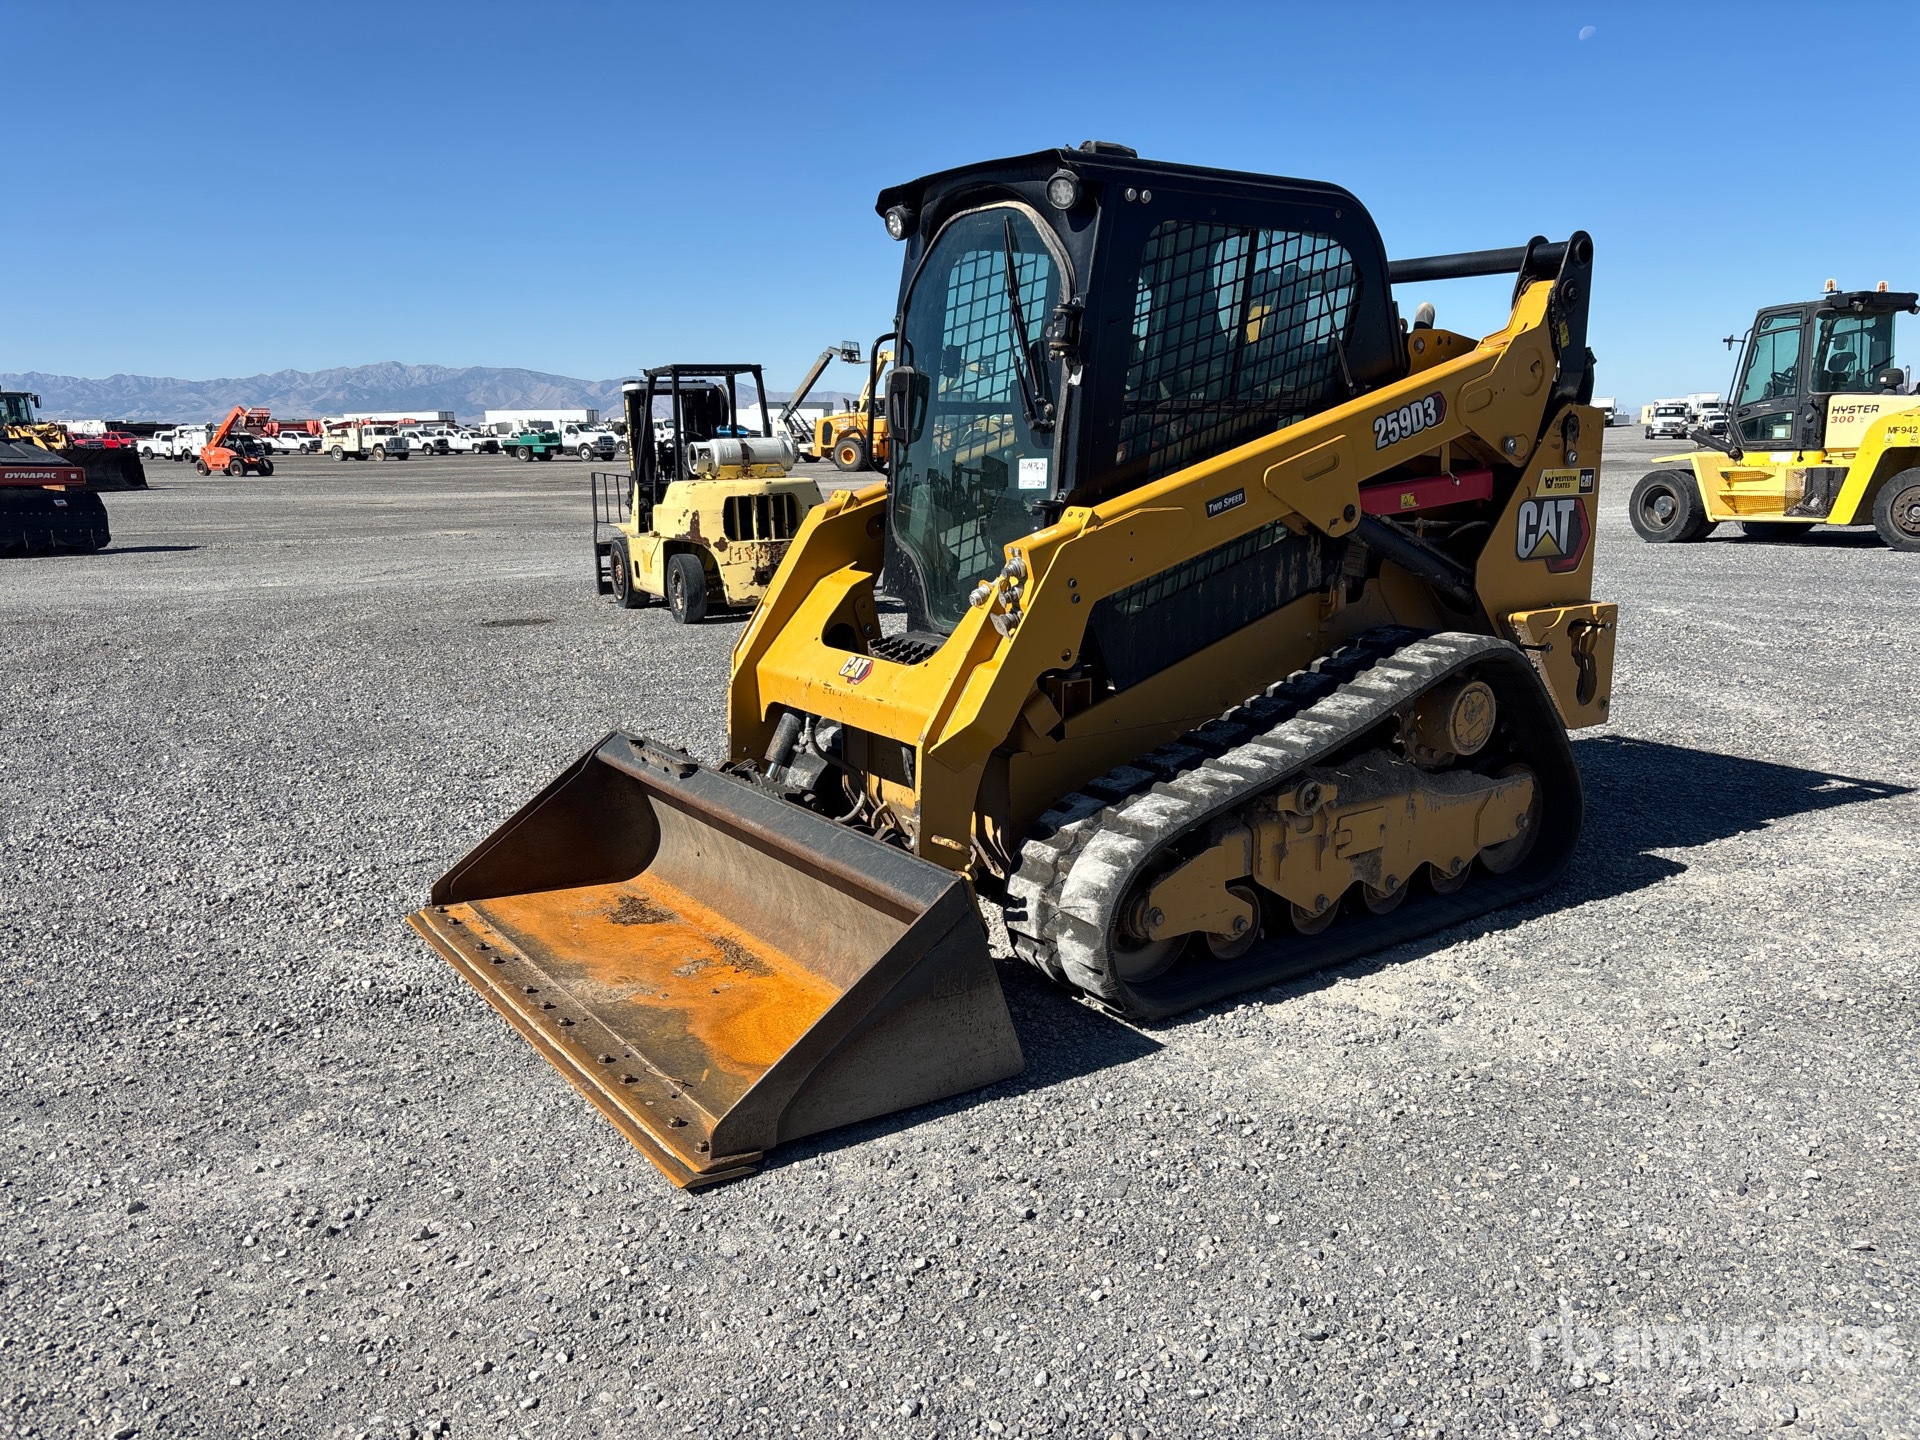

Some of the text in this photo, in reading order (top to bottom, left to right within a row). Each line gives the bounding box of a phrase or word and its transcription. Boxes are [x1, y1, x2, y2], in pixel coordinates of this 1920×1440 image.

[1831, 404, 1879, 414] HYSTER
[1374, 396, 1437, 449] 259D3
[1831, 415, 1855, 424] 300
[1887, 426, 1919, 435] MF942
[1580, 474, 1593, 487] CAT
[1517, 500, 1575, 559] CAT
[840, 656, 871, 679] CAT
